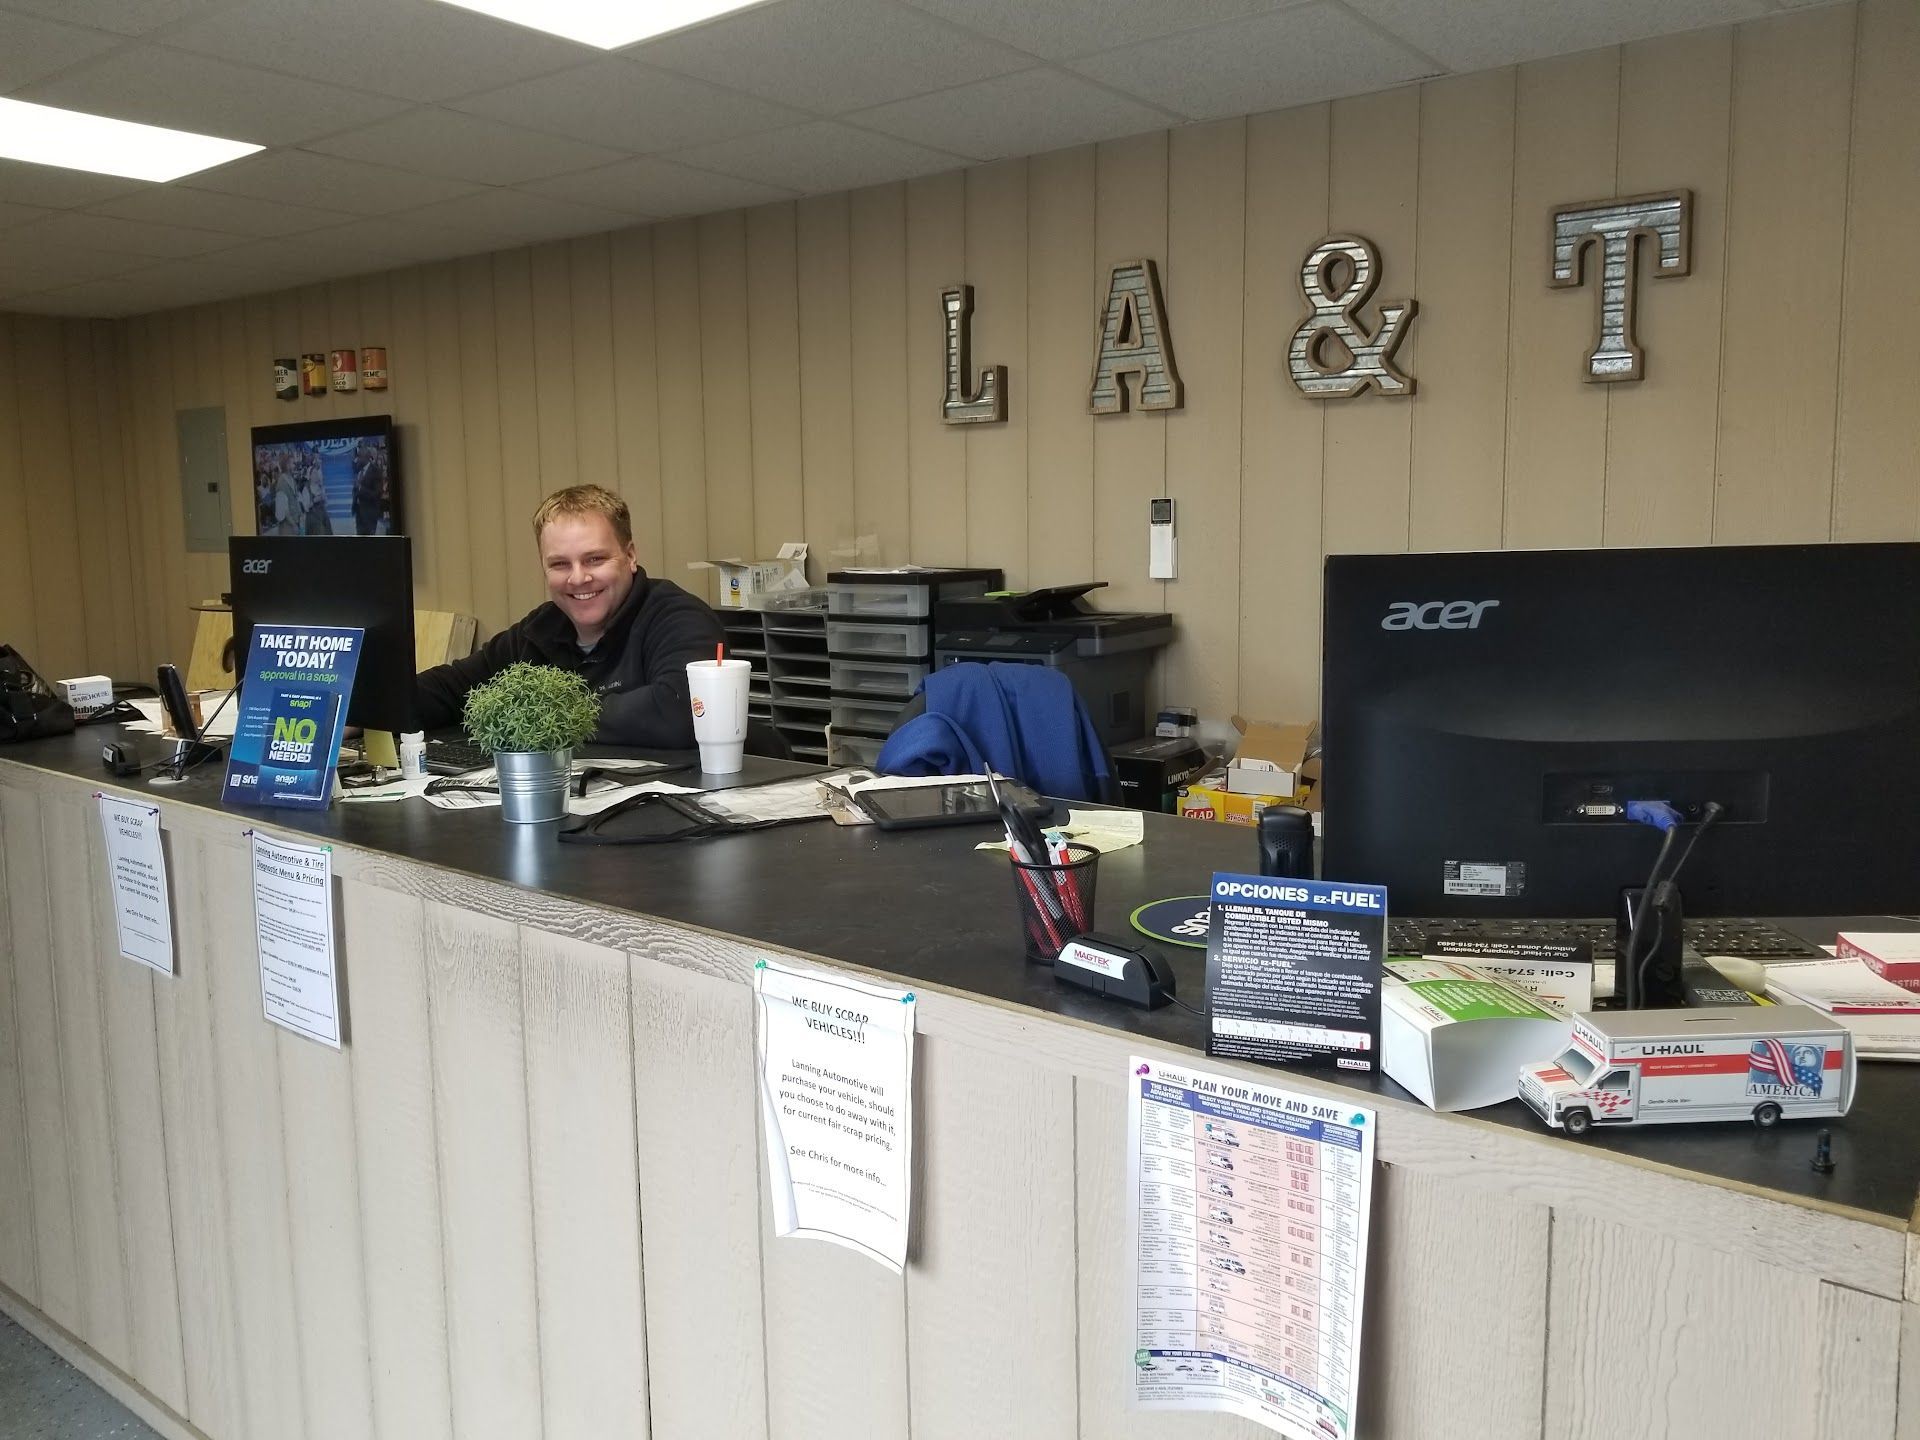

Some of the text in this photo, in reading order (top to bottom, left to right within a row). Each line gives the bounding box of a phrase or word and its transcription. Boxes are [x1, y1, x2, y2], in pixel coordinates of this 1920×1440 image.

[243, 559, 273, 574] acer
[1381, 599, 1500, 631] acer
[259, 634, 353, 652] TAKE IT HOME
[276, 650, 336, 669] TODAY!
[260, 670, 297, 682] approval
[298, 671, 305, 680] in
[313, 674, 339, 684] snap!
[290, 699, 312, 709] snap!
[273, 717, 317, 743] NO
[270, 740, 314, 753] CREDIT
[269, 751, 312, 763] NEEDED
[275, 774, 298, 785] snap!
[1185, 809, 1214, 820] GLAD
[256, 844, 324, 869] Lanning Automotive & Tire
[257, 859, 324, 887] Diagnostic Menu & Pricing
[1216, 881, 1309, 903] OPCIONES
[1225, 904, 1253, 913] LLENAR
[1265, 908, 1294, 917] TANQUE
[1225, 912, 1329, 928] COMBUSTIBLE USTED MISMO
[1074, 949, 1110, 967] MAGTEK
[1443, 946, 1481, 954] President
[1482, 948, 1520, 956] Company
[1222, 955, 1259, 965] SERVICIO
[1541, 968, 1576, 978] Cell:
[792, 995, 869, 1024] WE BUY SCRAP
[805, 1016, 865, 1044] VEHICLES!!!
[1574, 1023, 1603, 1052] U-HAUL
[1642, 1044, 1705, 1055] U-HAUL
[1338, 1059, 1369, 1068] U-HAUL
[791, 1058, 884, 1096] Lanning Automotive will
[781, 1073, 895, 1117] purchase your vehicle, should
[1158, 1070, 1187, 1083] U-HAUL
[1192, 1078, 1217, 1094] PLAN
[1221, 1084, 1249, 1100] YOUR
[1252, 1091, 1282, 1108] MOVE
[1285, 1100, 1308, 1114] AND
[1312, 1105, 1339, 1121] SAVE
[1748, 1083, 1818, 1097] AMERICA
[779, 1089, 896, 1137] you choose to do away with it,
[783, 1105, 893, 1152] for current fair scrap pricing.
[790, 1145, 887, 1187] See Chris for more info...
